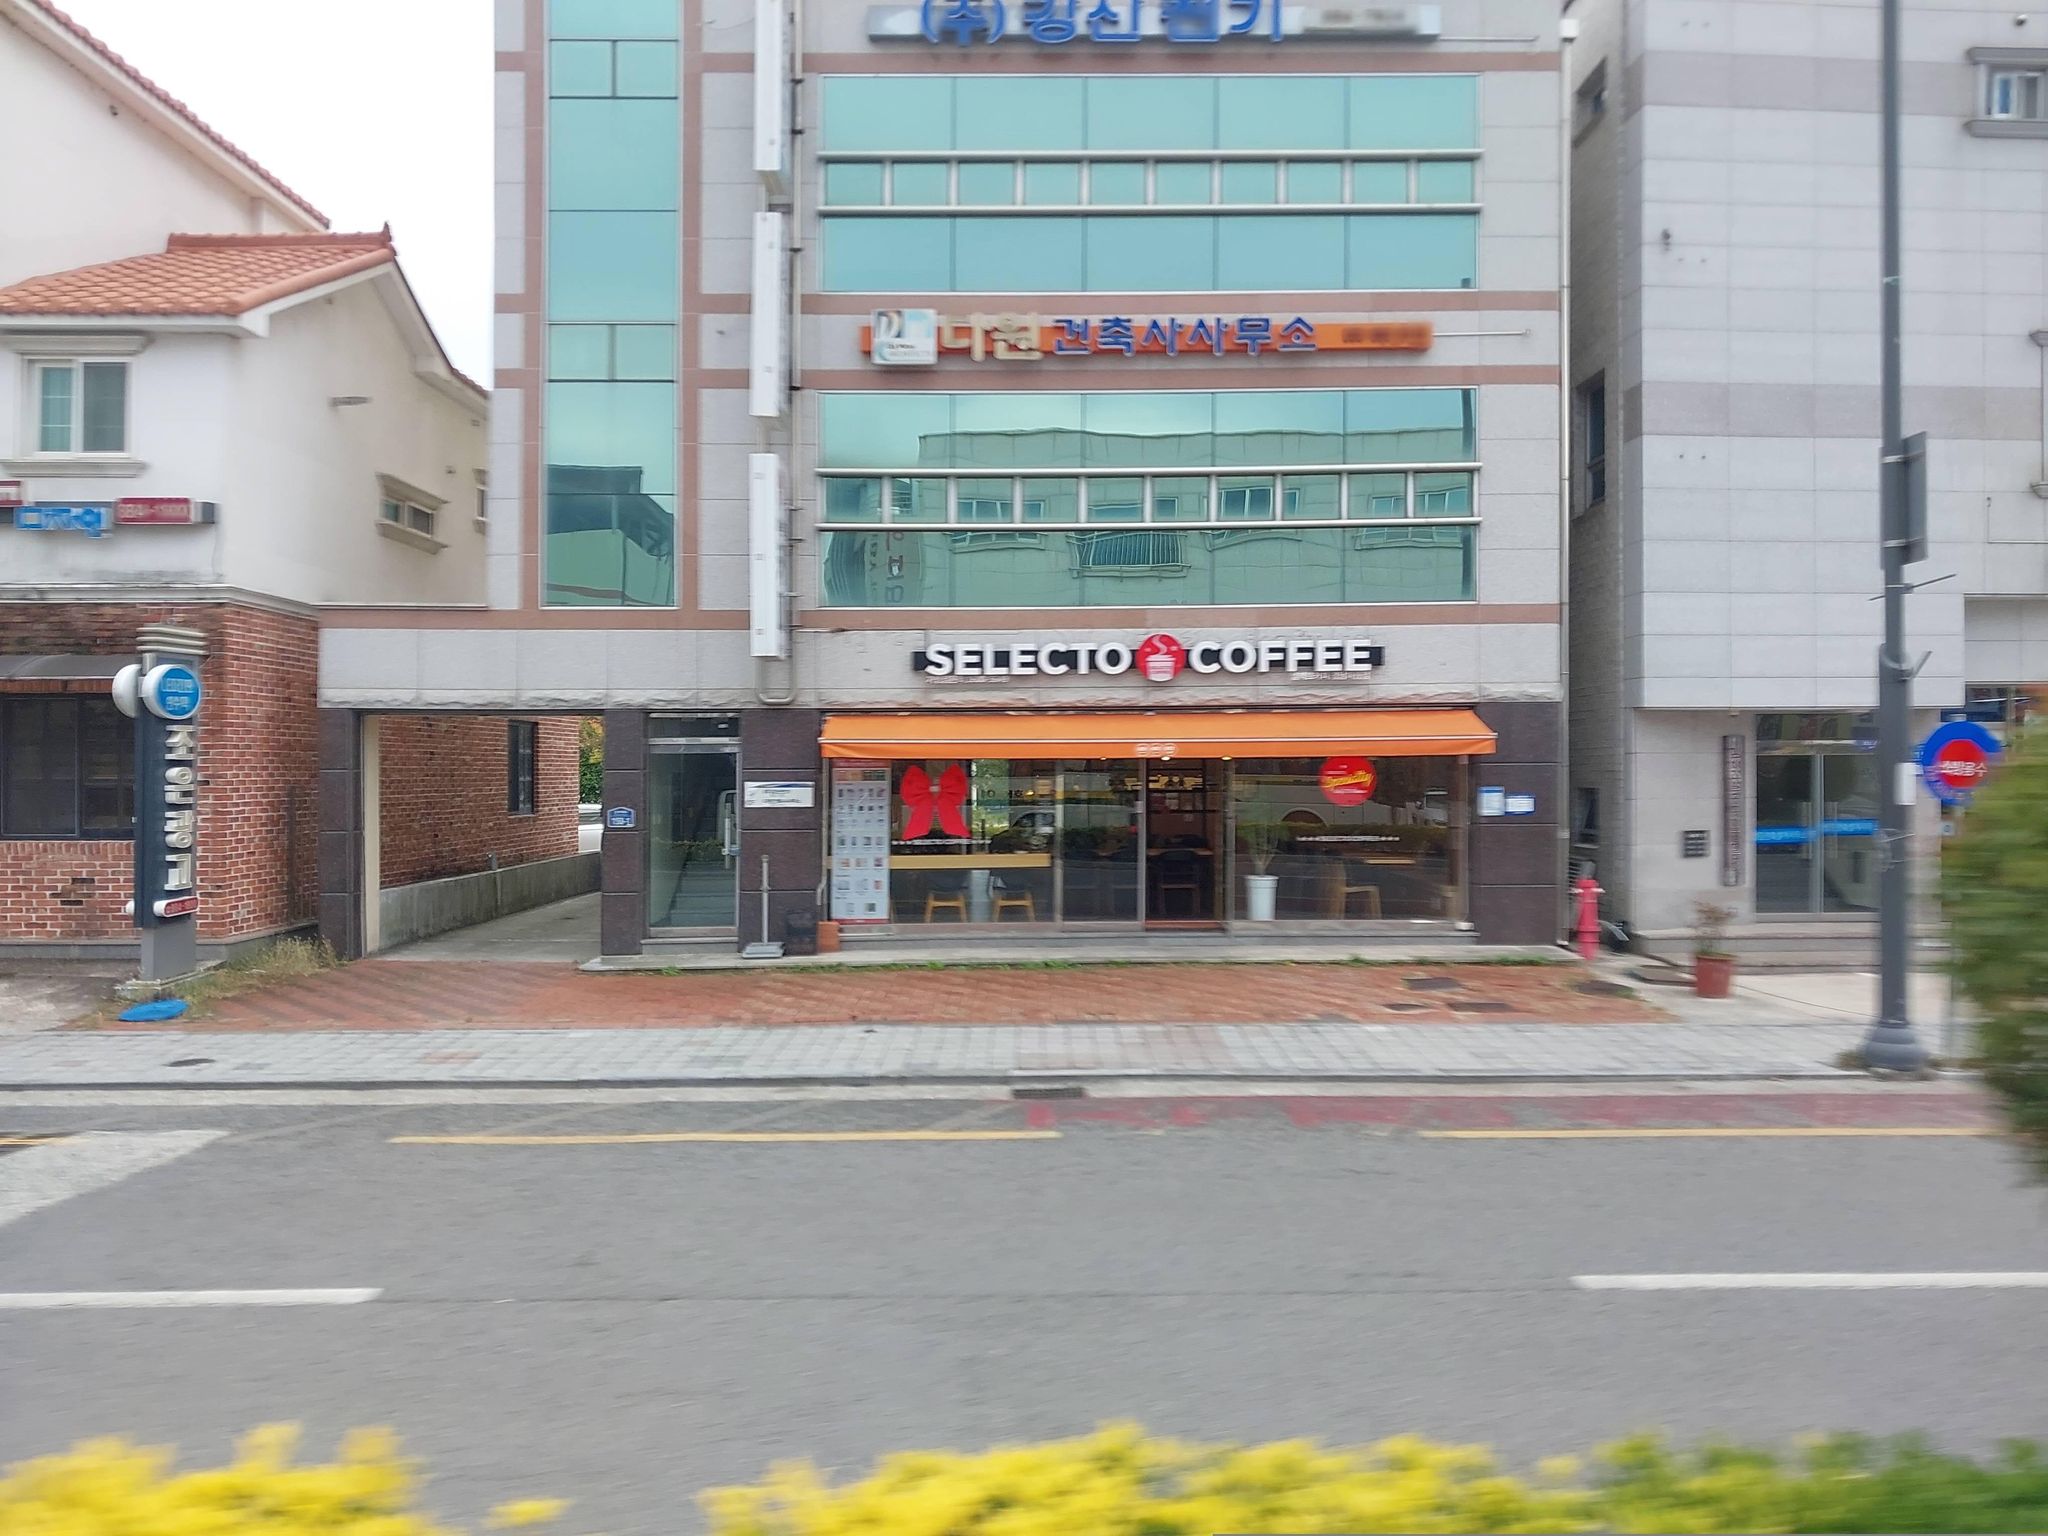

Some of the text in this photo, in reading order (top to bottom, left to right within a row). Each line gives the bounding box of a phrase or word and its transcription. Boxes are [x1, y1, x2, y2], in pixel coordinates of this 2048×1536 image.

[940, 312, 1043, 361] 다원
[1051, 316, 1317, 358] 건축사사무소
[925, 639, 1372, 675] SELECTO COFFEE
